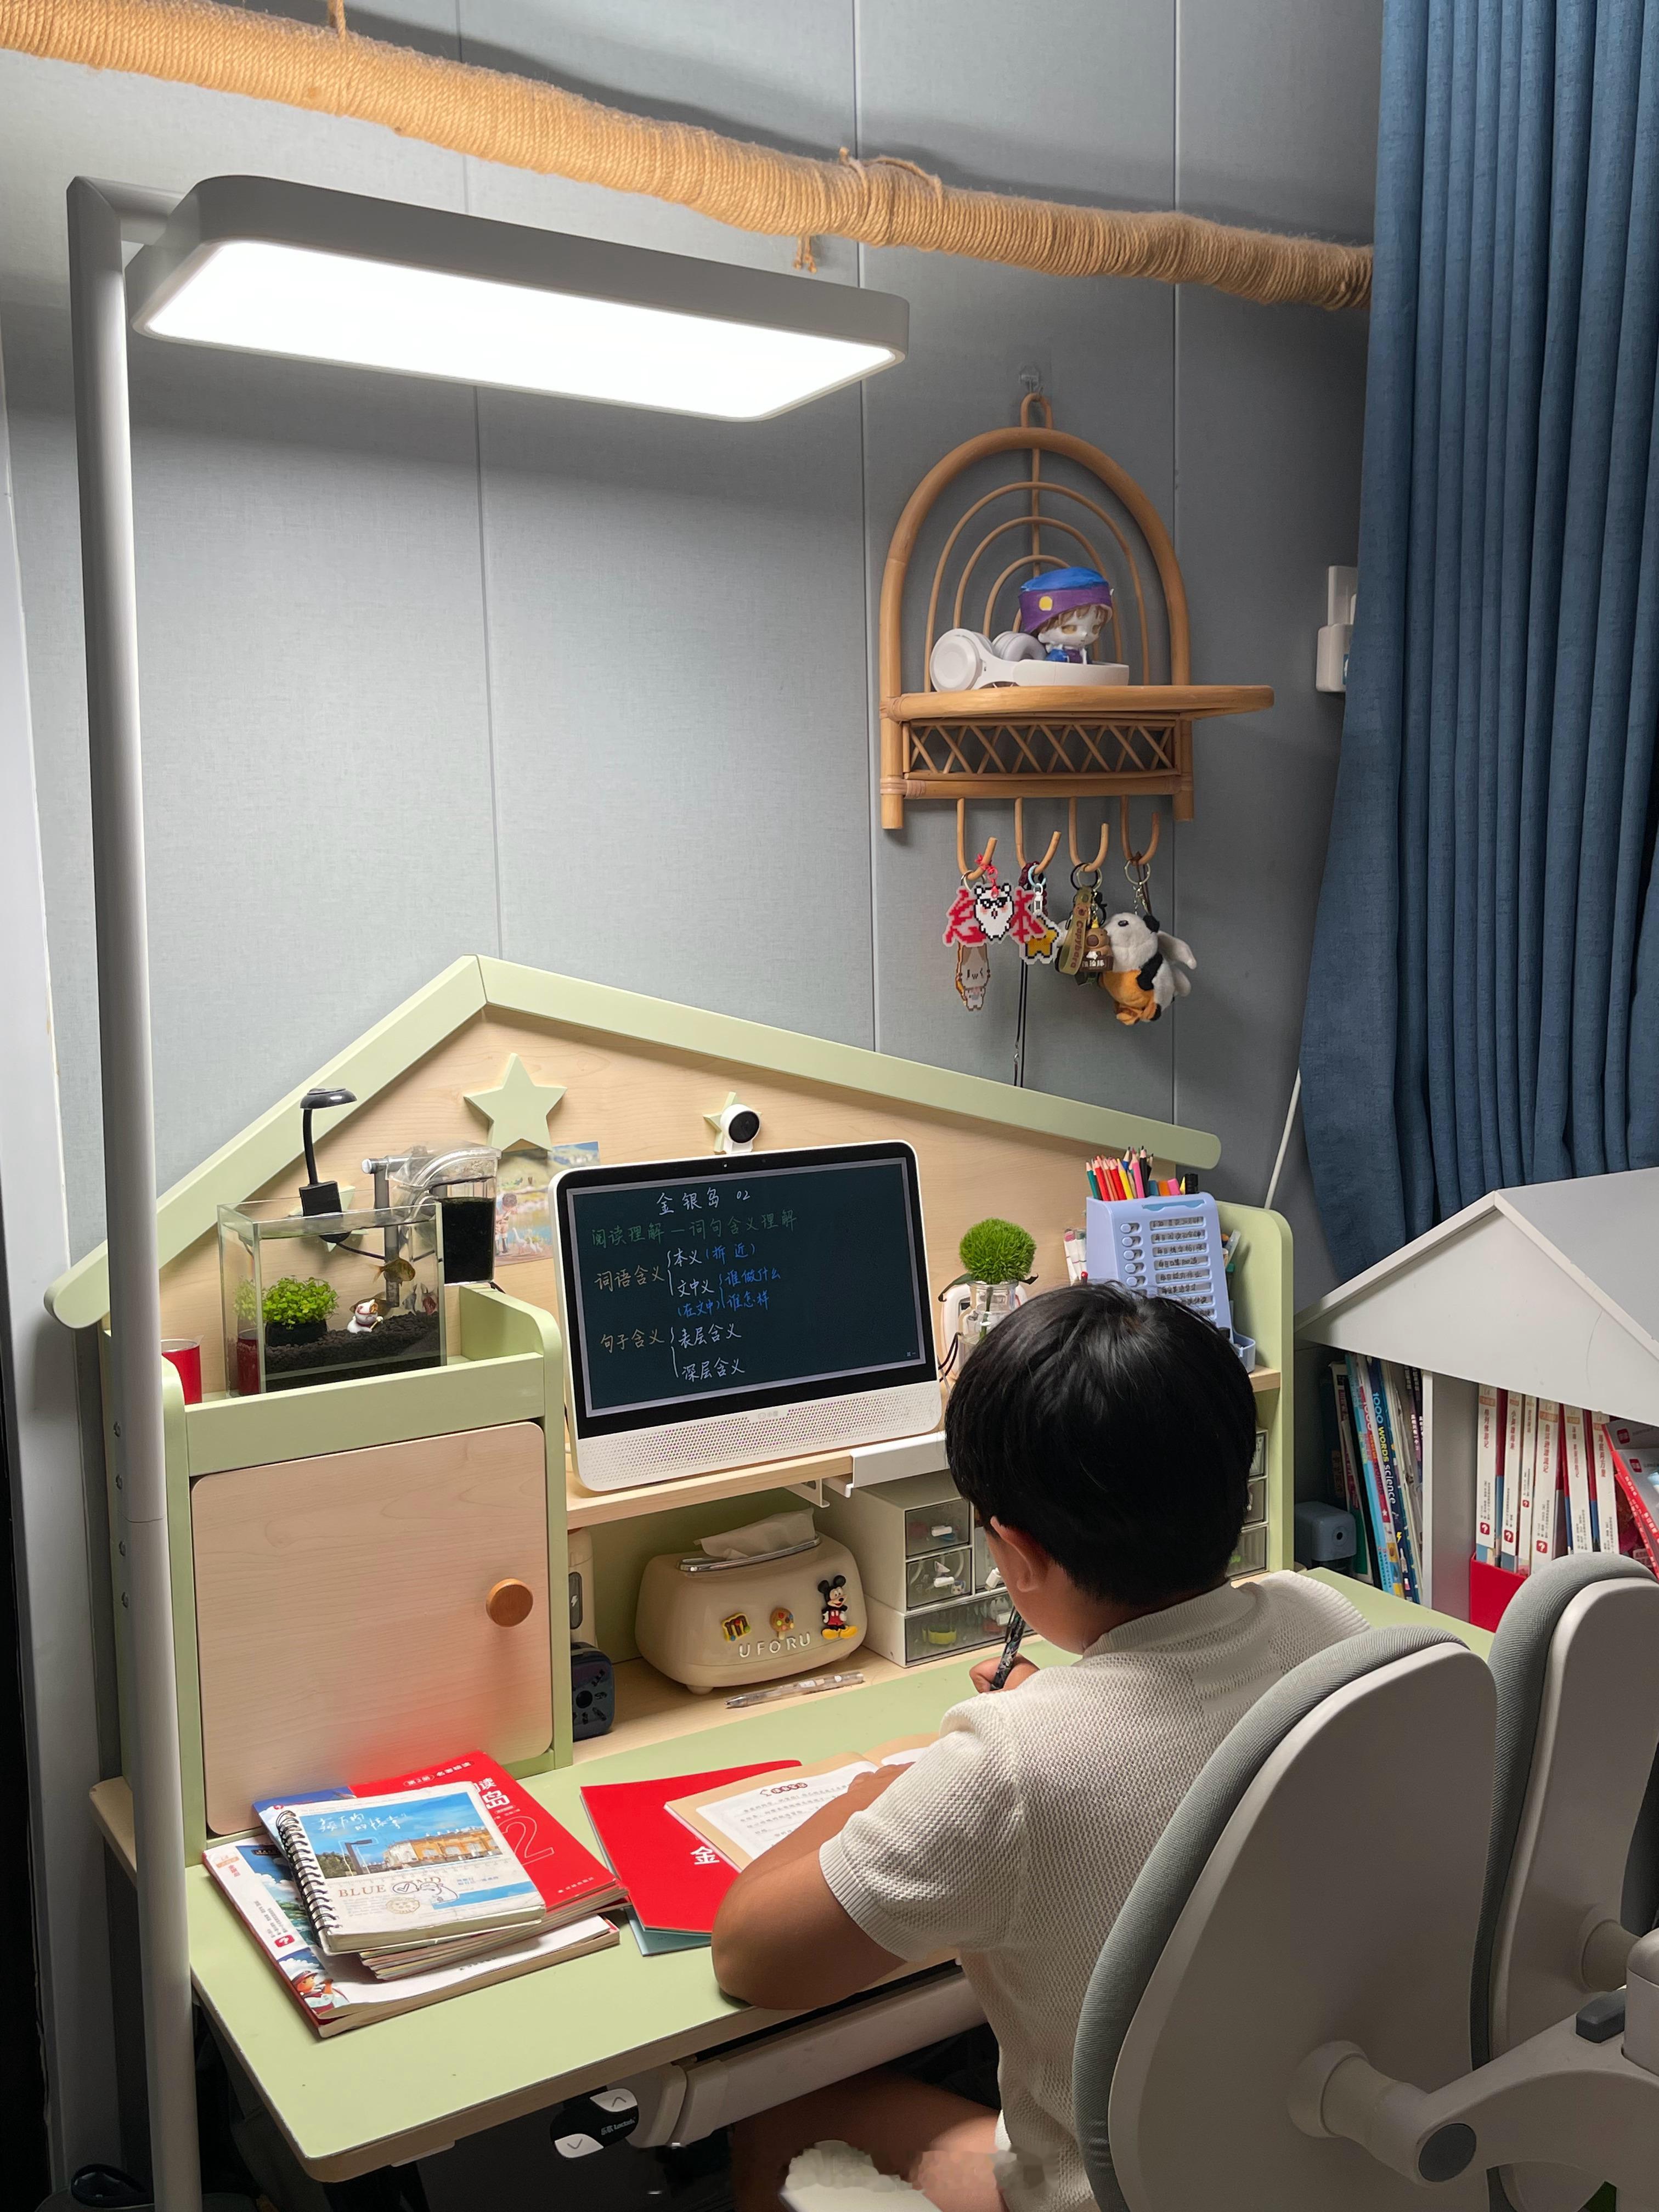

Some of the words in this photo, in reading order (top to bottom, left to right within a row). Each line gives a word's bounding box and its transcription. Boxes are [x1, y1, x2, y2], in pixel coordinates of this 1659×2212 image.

[1070, 920, 1084, 968] Capybara
[656, 1187, 720, 1216] 金银岛
[736, 1189, 751, 1201] 02
[673, 1247, 703, 1266] 本义
[594, 1264, 665, 1293] 词语含义
[677, 1279, 715, 1297] 文中义
[725, 1267, 782, 1286] 谁做什么
[727, 1290, 770, 1312] 谁怎样
[600, 1328, 665, 1354] 句子含义
[678, 1323, 742, 1350] 表层含义
[681, 1357, 746, 1383] 深层含义
[1372, 1392, 1384, 1424] 1000
[1378, 1427, 1390, 1463] WORDS
[1384, 1463, 1396, 1504] science
[738, 1632, 812, 1658] UFORU
[483, 1790, 510, 1810] 岛
[690, 1846, 720, 1866] 金
[338, 1884, 387, 1898] BLUE
